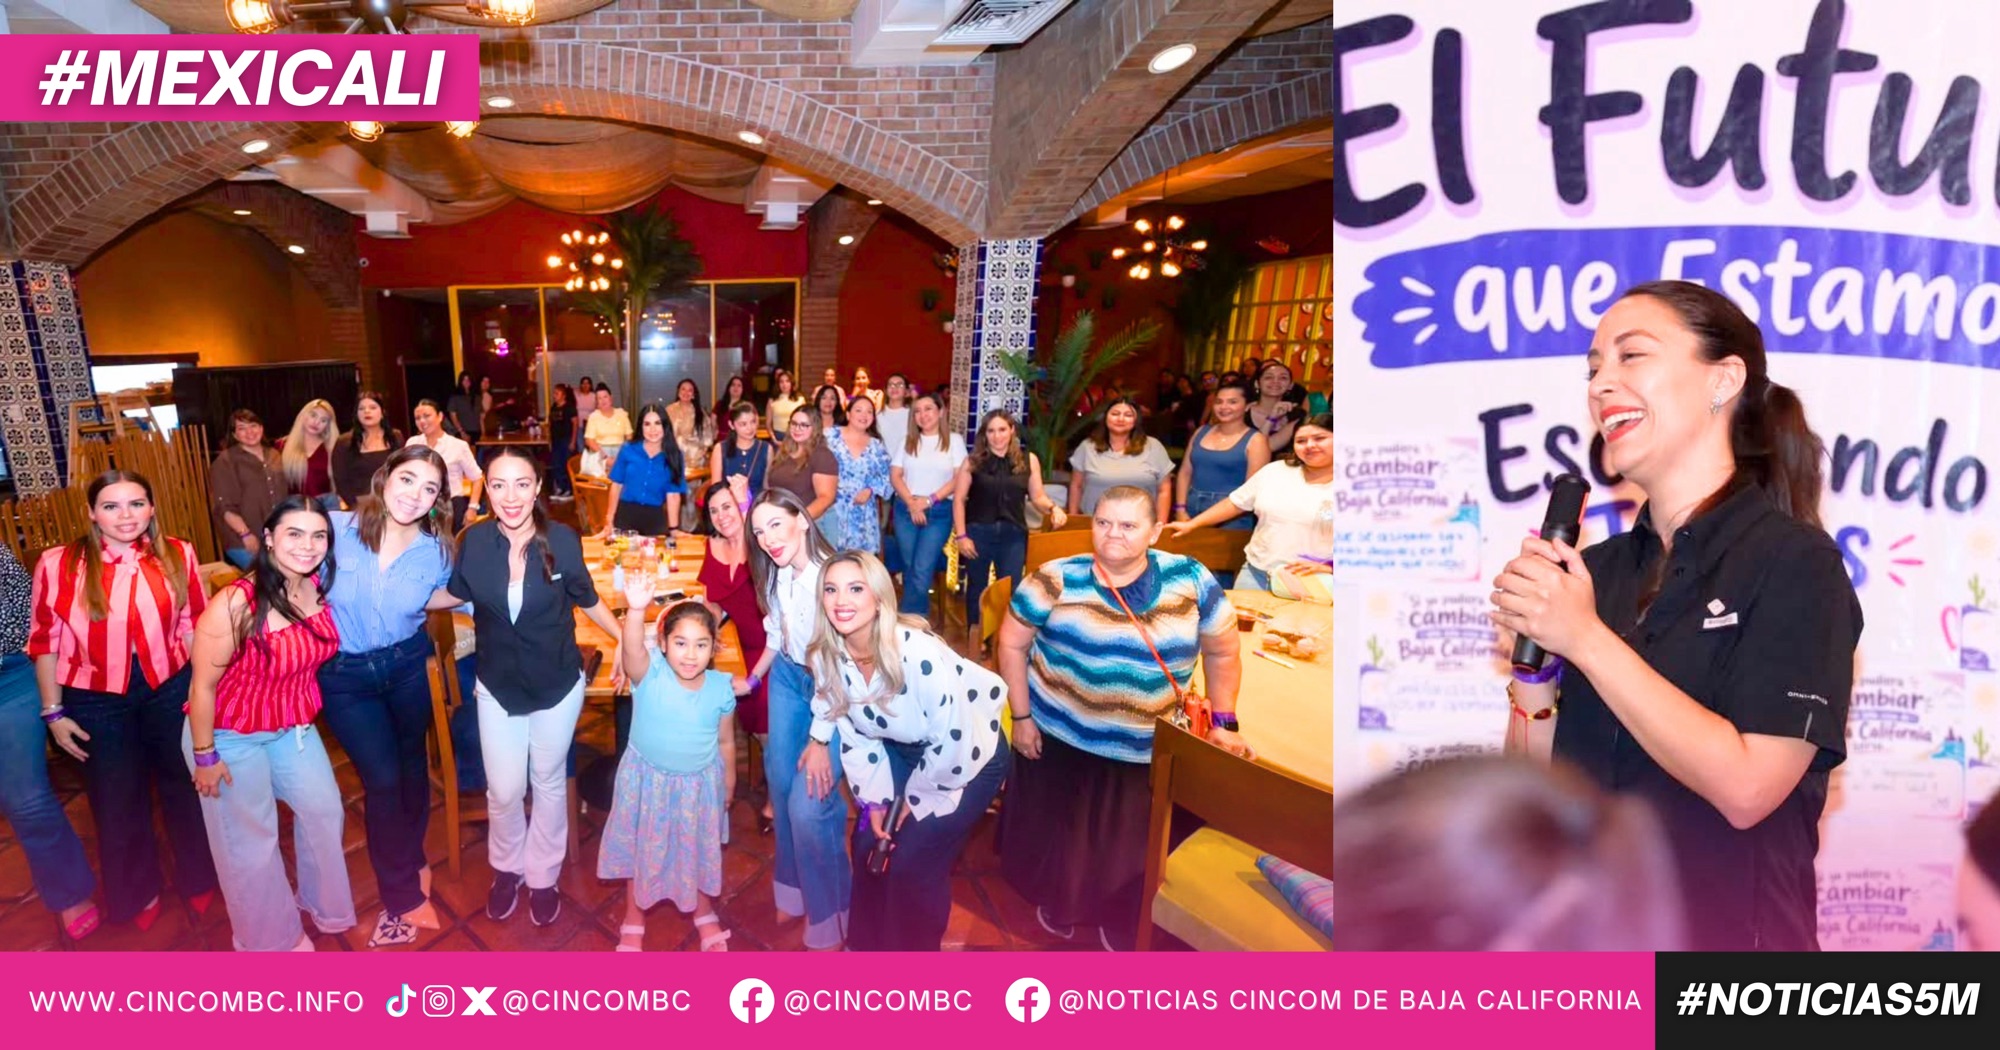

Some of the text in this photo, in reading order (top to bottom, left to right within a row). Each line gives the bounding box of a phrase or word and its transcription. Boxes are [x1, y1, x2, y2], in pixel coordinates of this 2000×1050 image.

[1334, 0, 2000, 229] El Futu
[1453, 259, 1617, 351] que
[1345, 457, 1440, 479] cambiar
[1478, 403, 1986, 513] Escndo
[1377, 488, 1449, 508] California
[1398, 638, 1435, 662] Baja
[1849, 688, 1924, 709] mbiar
[1859, 719, 1933, 742] California
